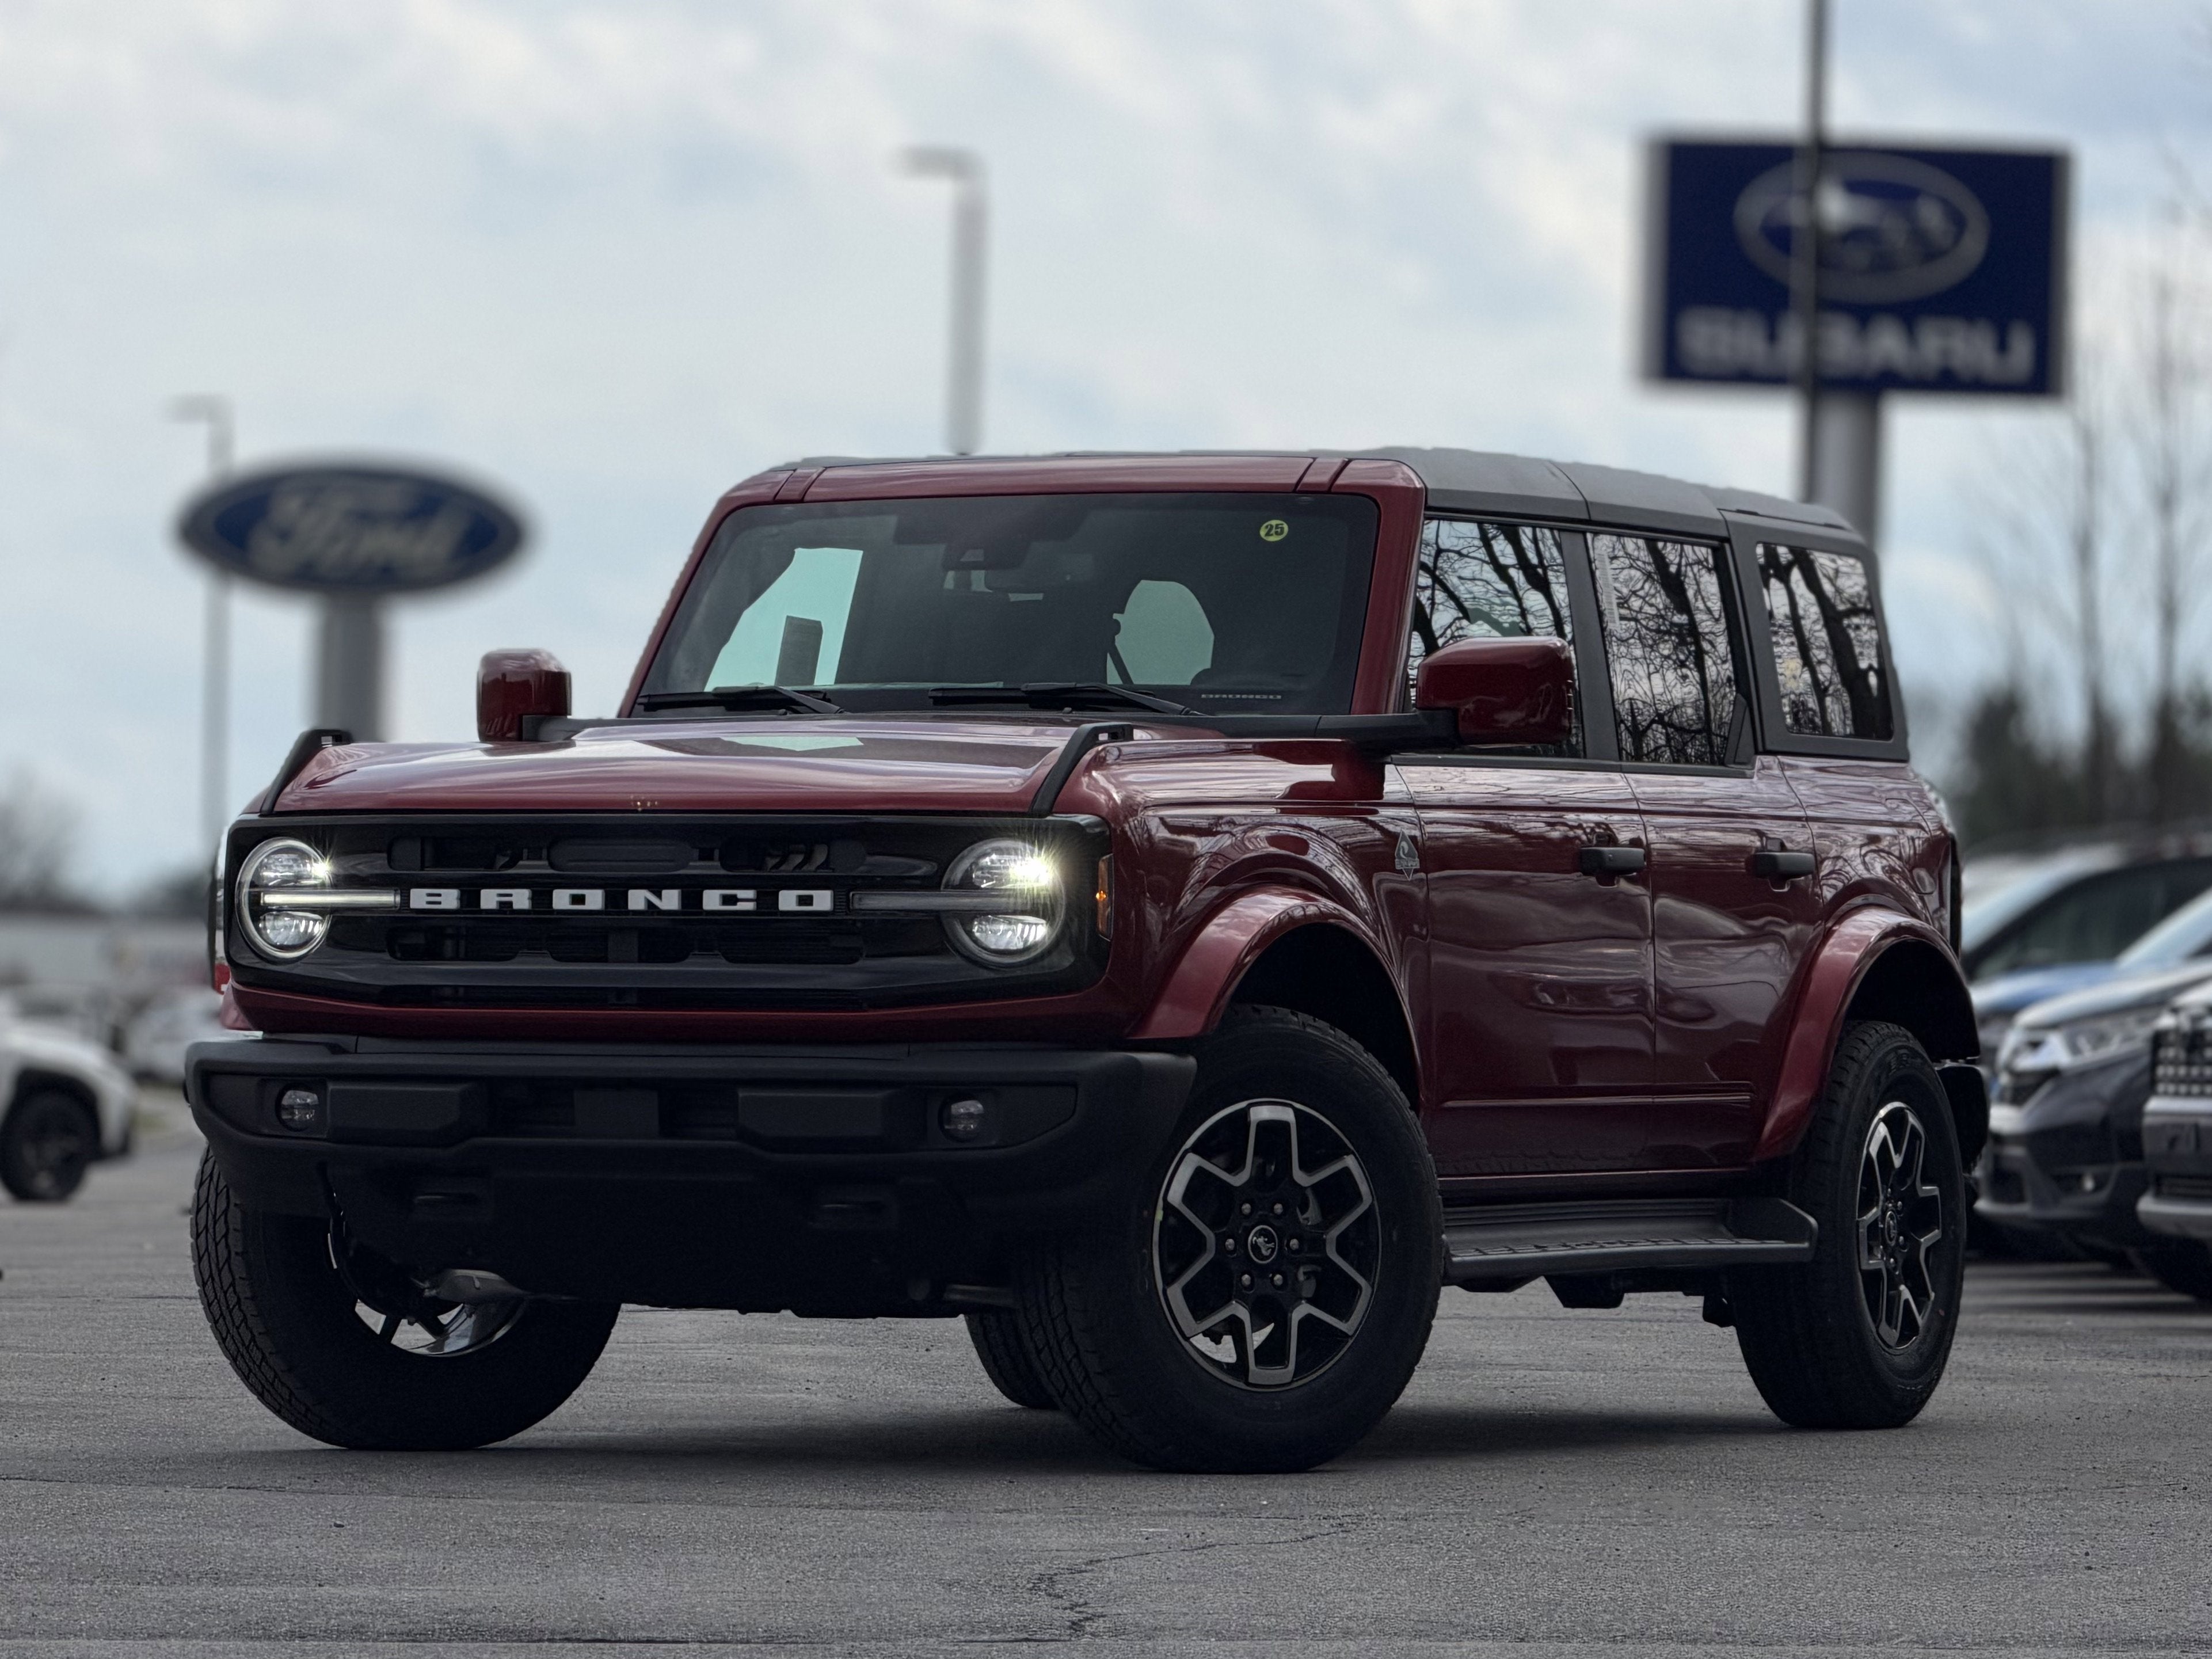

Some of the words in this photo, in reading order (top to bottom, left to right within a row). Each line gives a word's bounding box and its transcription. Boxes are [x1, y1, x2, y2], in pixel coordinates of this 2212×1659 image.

[1676, 305, 2036, 386] SUBARU
[248, 480, 470, 577] Ford
[1264, 523, 1285, 536] 25
[409, 888, 833, 911] BRONCO
